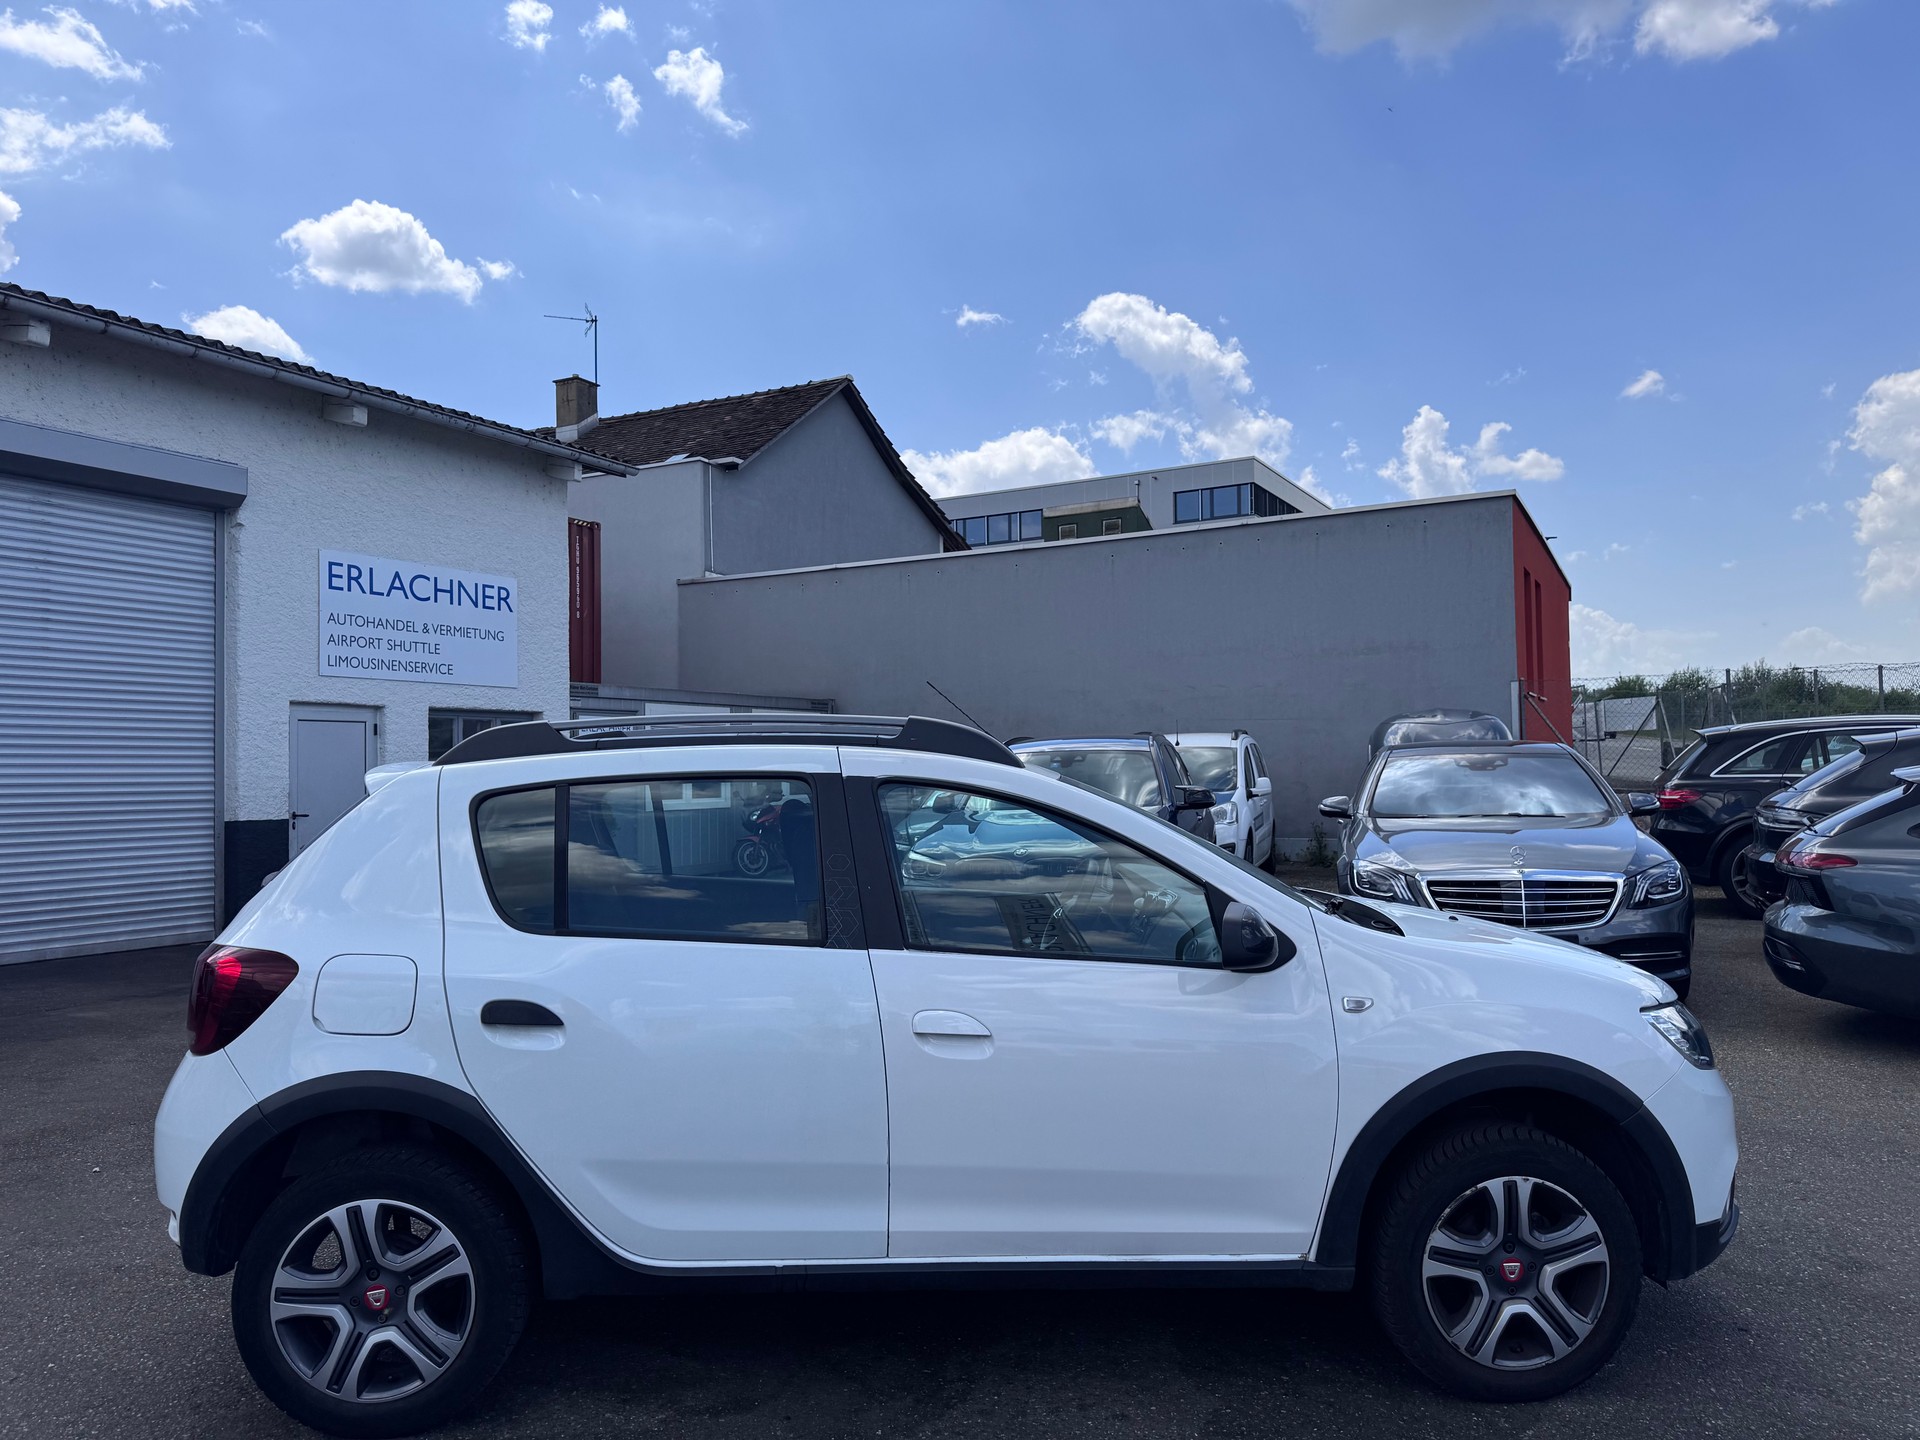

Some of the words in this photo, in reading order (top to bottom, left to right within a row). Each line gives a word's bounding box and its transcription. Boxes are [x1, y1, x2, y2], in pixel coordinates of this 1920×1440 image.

[327, 561, 514, 613] ERLACHNER
[327, 612, 419, 634] AUTOHANDEL
[422, 623, 431, 635] &
[431, 623, 505, 642] VERMIETUNG
[327, 633, 383, 650] AIRPORT
[387, 639, 441, 655] SHUTTLE
[327, 654, 454, 676] LIMOUSINENSERVICE
